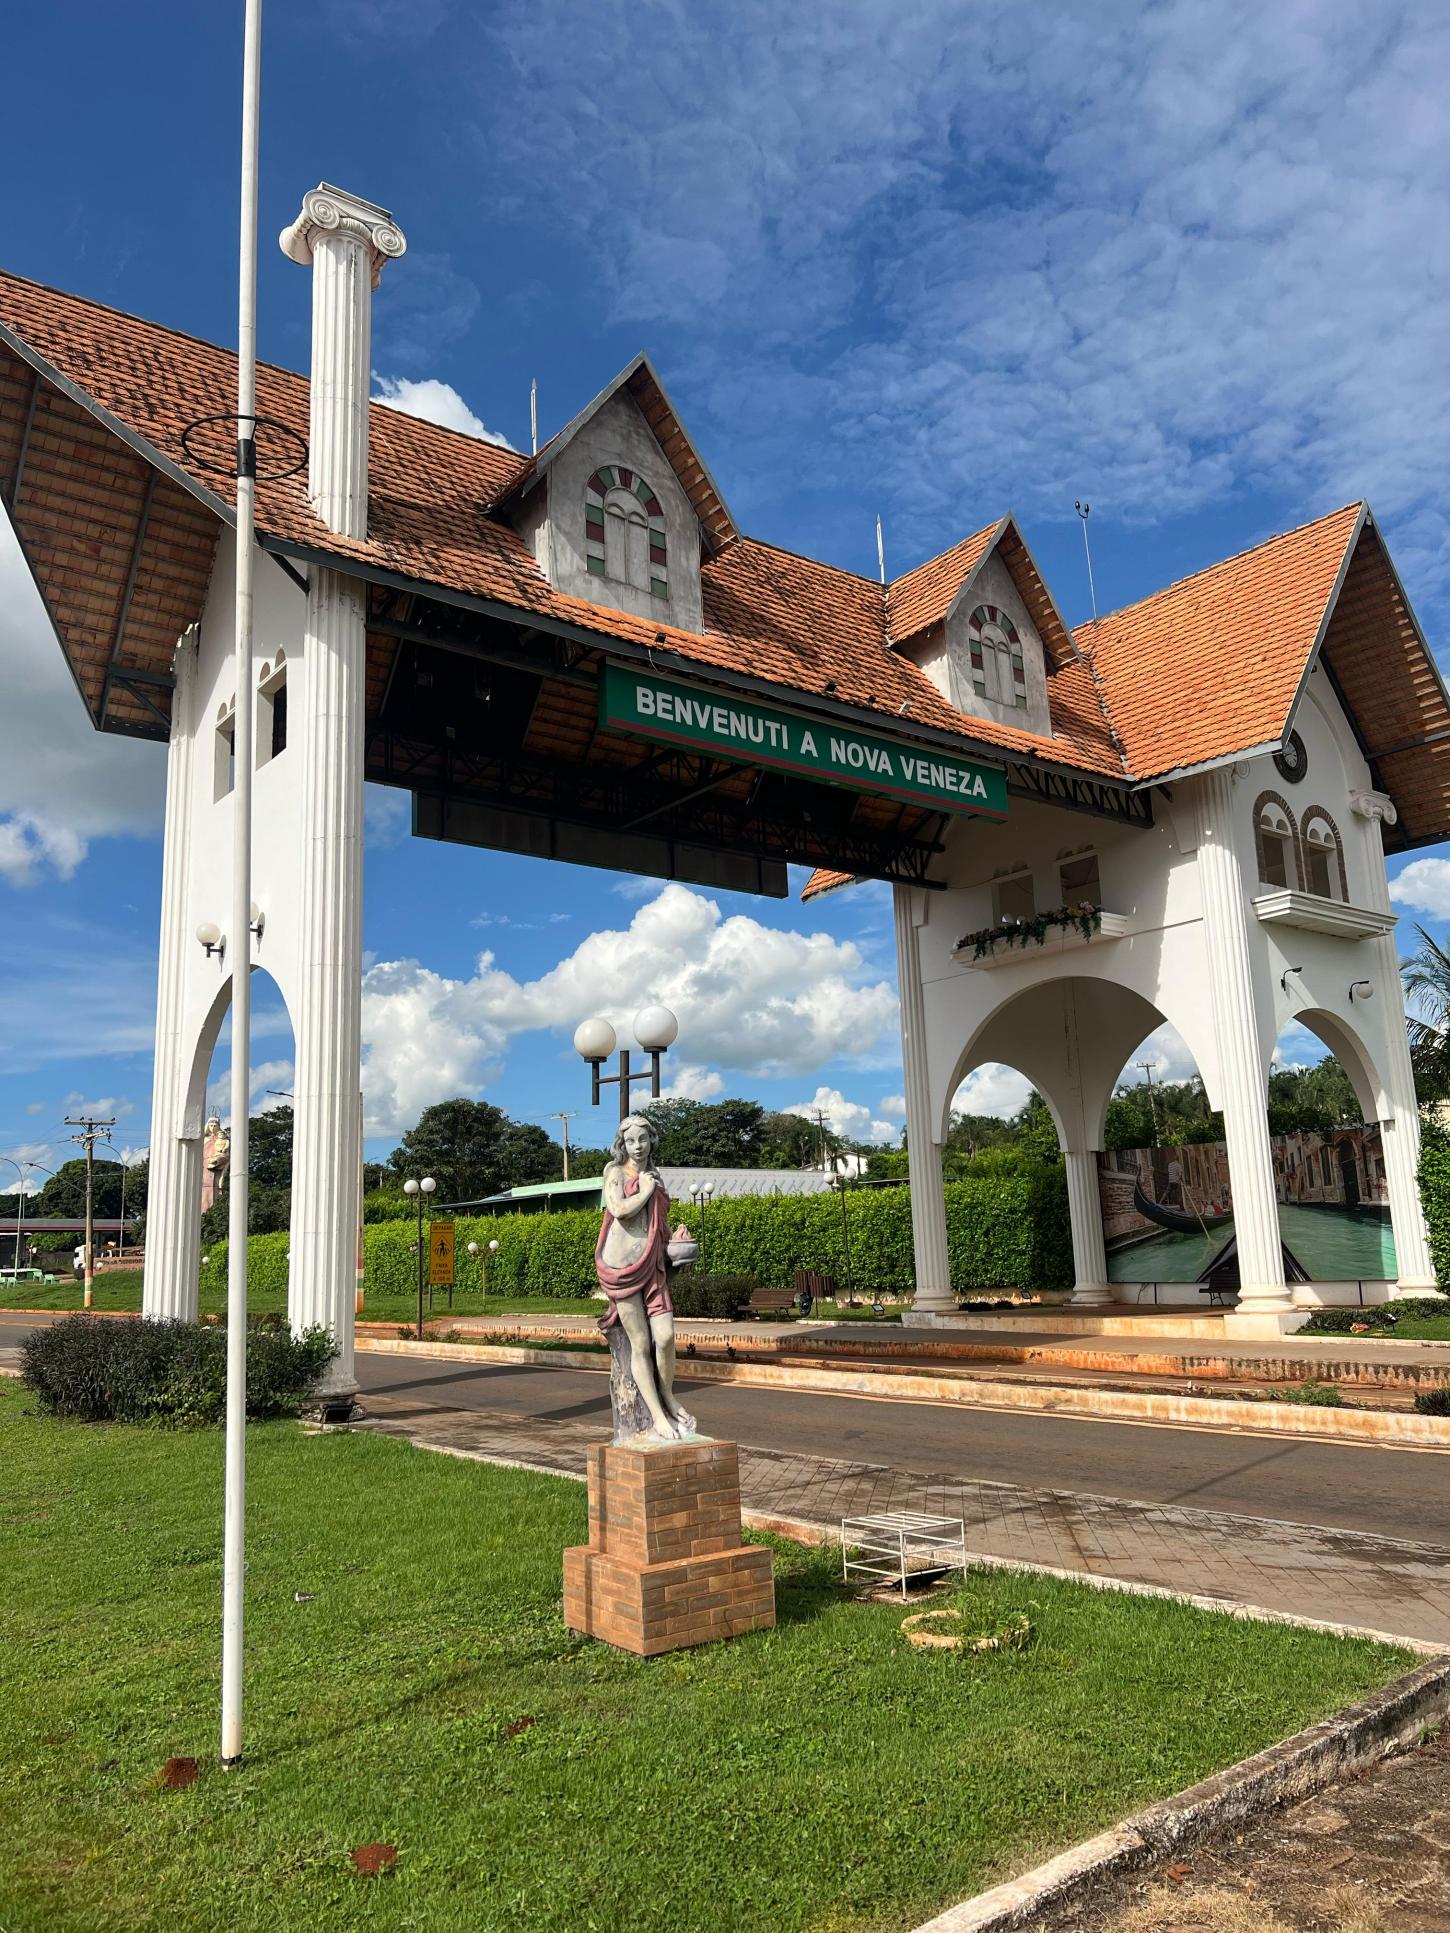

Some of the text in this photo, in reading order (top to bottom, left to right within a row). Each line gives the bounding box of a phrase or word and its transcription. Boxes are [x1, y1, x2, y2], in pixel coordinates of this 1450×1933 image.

[636, 686, 988, 799] BENVENUTI A NOVA VENEZA
